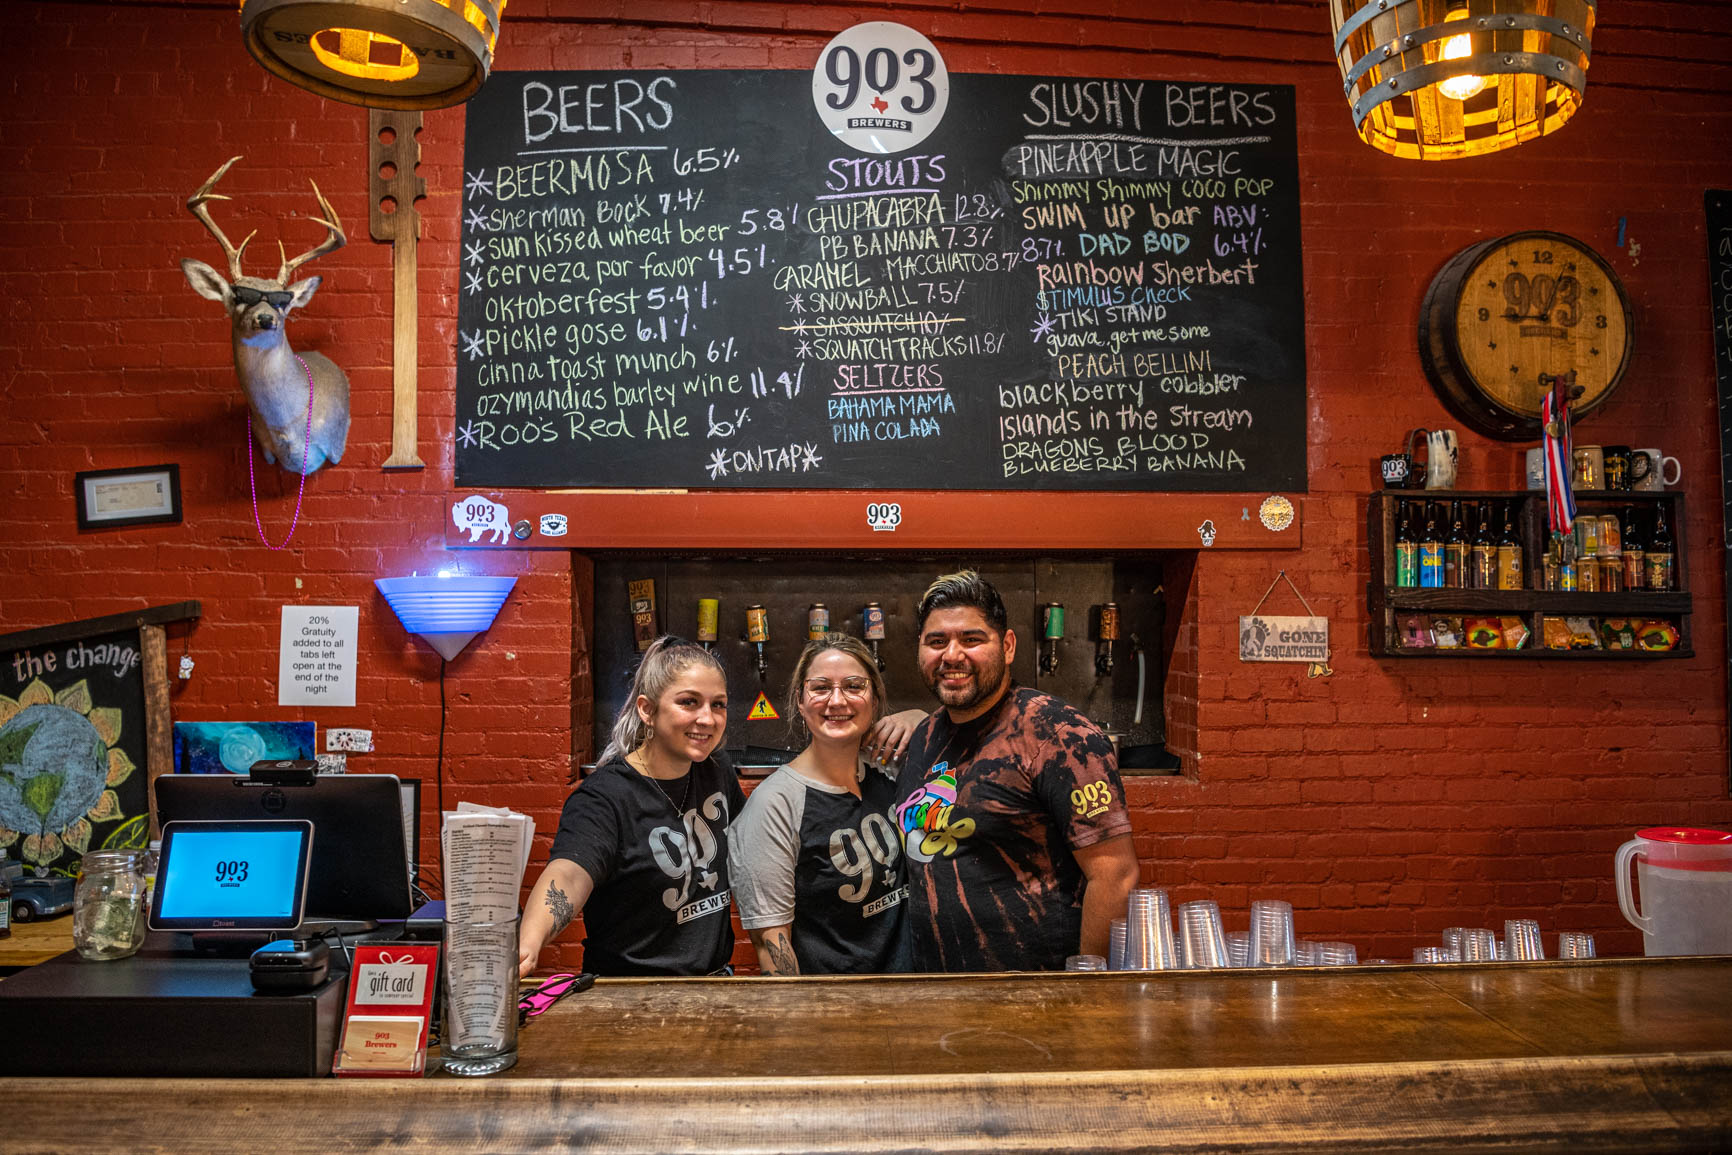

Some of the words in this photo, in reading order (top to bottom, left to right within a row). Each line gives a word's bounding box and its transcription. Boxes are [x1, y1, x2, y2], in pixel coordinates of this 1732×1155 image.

[825, 46, 936, 113] 903
[523, 77, 676, 145] BEERS
[1023, 81, 1144, 131] SLUSHY
[1166, 84, 1276, 128] BEERS
[851, 118, 908, 129] BREWERS
[825, 155, 946, 191] STOUTS
[1018, 142, 1147, 177] PINEAPPLE
[1158, 147, 1242, 178] MAGIC
[496, 152, 654, 201] BEERMOSA
[808, 193, 945, 233] CHUPACABRA
[1023, 202, 1087, 230] SWIM
[608, 222, 672, 246] wheat
[679, 219, 729, 242] beer
[820, 234, 848, 261] PB
[853, 227, 940, 258] BANANA
[1079, 232, 1132, 258] DAD
[1143, 230, 1190, 255] BOD
[486, 260, 590, 288] cerveza
[597, 258, 633, 283] por
[640, 252, 702, 280] favor
[774, 262, 871, 291] CARAMEL
[886, 252, 983, 281] MACCHIATO
[1533, 251, 1553, 264] 12
[810, 285, 918, 313] SNOWBALL
[1503, 272, 1582, 327] 903
[1055, 309, 1099, 330] TIKI
[1105, 304, 1167, 323] STAND
[1596, 315, 1607, 328] 3
[566, 321, 627, 355] gose
[479, 359, 543, 387] cinna
[547, 353, 605, 381] toast
[616, 343, 696, 377] munch
[834, 363, 943, 391] SELTZERS
[1058, 353, 1126, 378] PEACH
[1133, 350, 1213, 377] BELLINI
[477, 379, 606, 417] ozymandias
[614, 381, 675, 407] barley
[684, 372, 742, 397] wine
[998, 379, 1144, 408] blackberry
[1160, 374, 1247, 396] cobbler
[828, 396, 896, 420] BAHAMA
[900, 392, 956, 415] MAMA
[1090, 407, 1110, 432] in
[1115, 404, 1158, 431] the
[564, 412, 633, 440] Red
[647, 409, 689, 440] Ale
[833, 421, 870, 443] PINA
[875, 416, 941, 441] COLADA
[1002, 437, 1104, 460] DRAGONS
[1117, 432, 1209, 457] BLOOD
[1003, 454, 1138, 478] BLUEBERRY
[1148, 449, 1246, 472] BANANA
[1383, 461, 1406, 477] 903
[466, 504, 495, 523] 903
[868, 505, 900, 524] 903
[301, 627, 336, 638] Gratuity
[309, 616, 330, 625] 20%
[292, 639, 321, 648] added
[323, 640, 332, 648] to
[334, 639, 344, 648] all
[1279, 631, 1326, 643] GONE
[13, 650, 57, 682] the
[66, 641, 141, 678] change
[292, 663, 315, 671] open
[328, 662, 342, 671] the
[300, 651, 319, 659] tabs
[321, 651, 335, 659] left
[1264, 646, 1327, 660] SQUATCHIN
[294, 673, 312, 681] end
[313, 673, 322, 681] of
[325, 673, 339, 682] the
[305, 685, 327, 695] night
[1071, 781, 1112, 815] 903
[829, 803, 897, 903] 90
[216, 861, 249, 881] 903
[370, 971, 389, 996] gift
[392, 971, 415, 992] card
[365, 1040, 397, 1048] Brewers
[375, 1032, 390, 1040] 903
